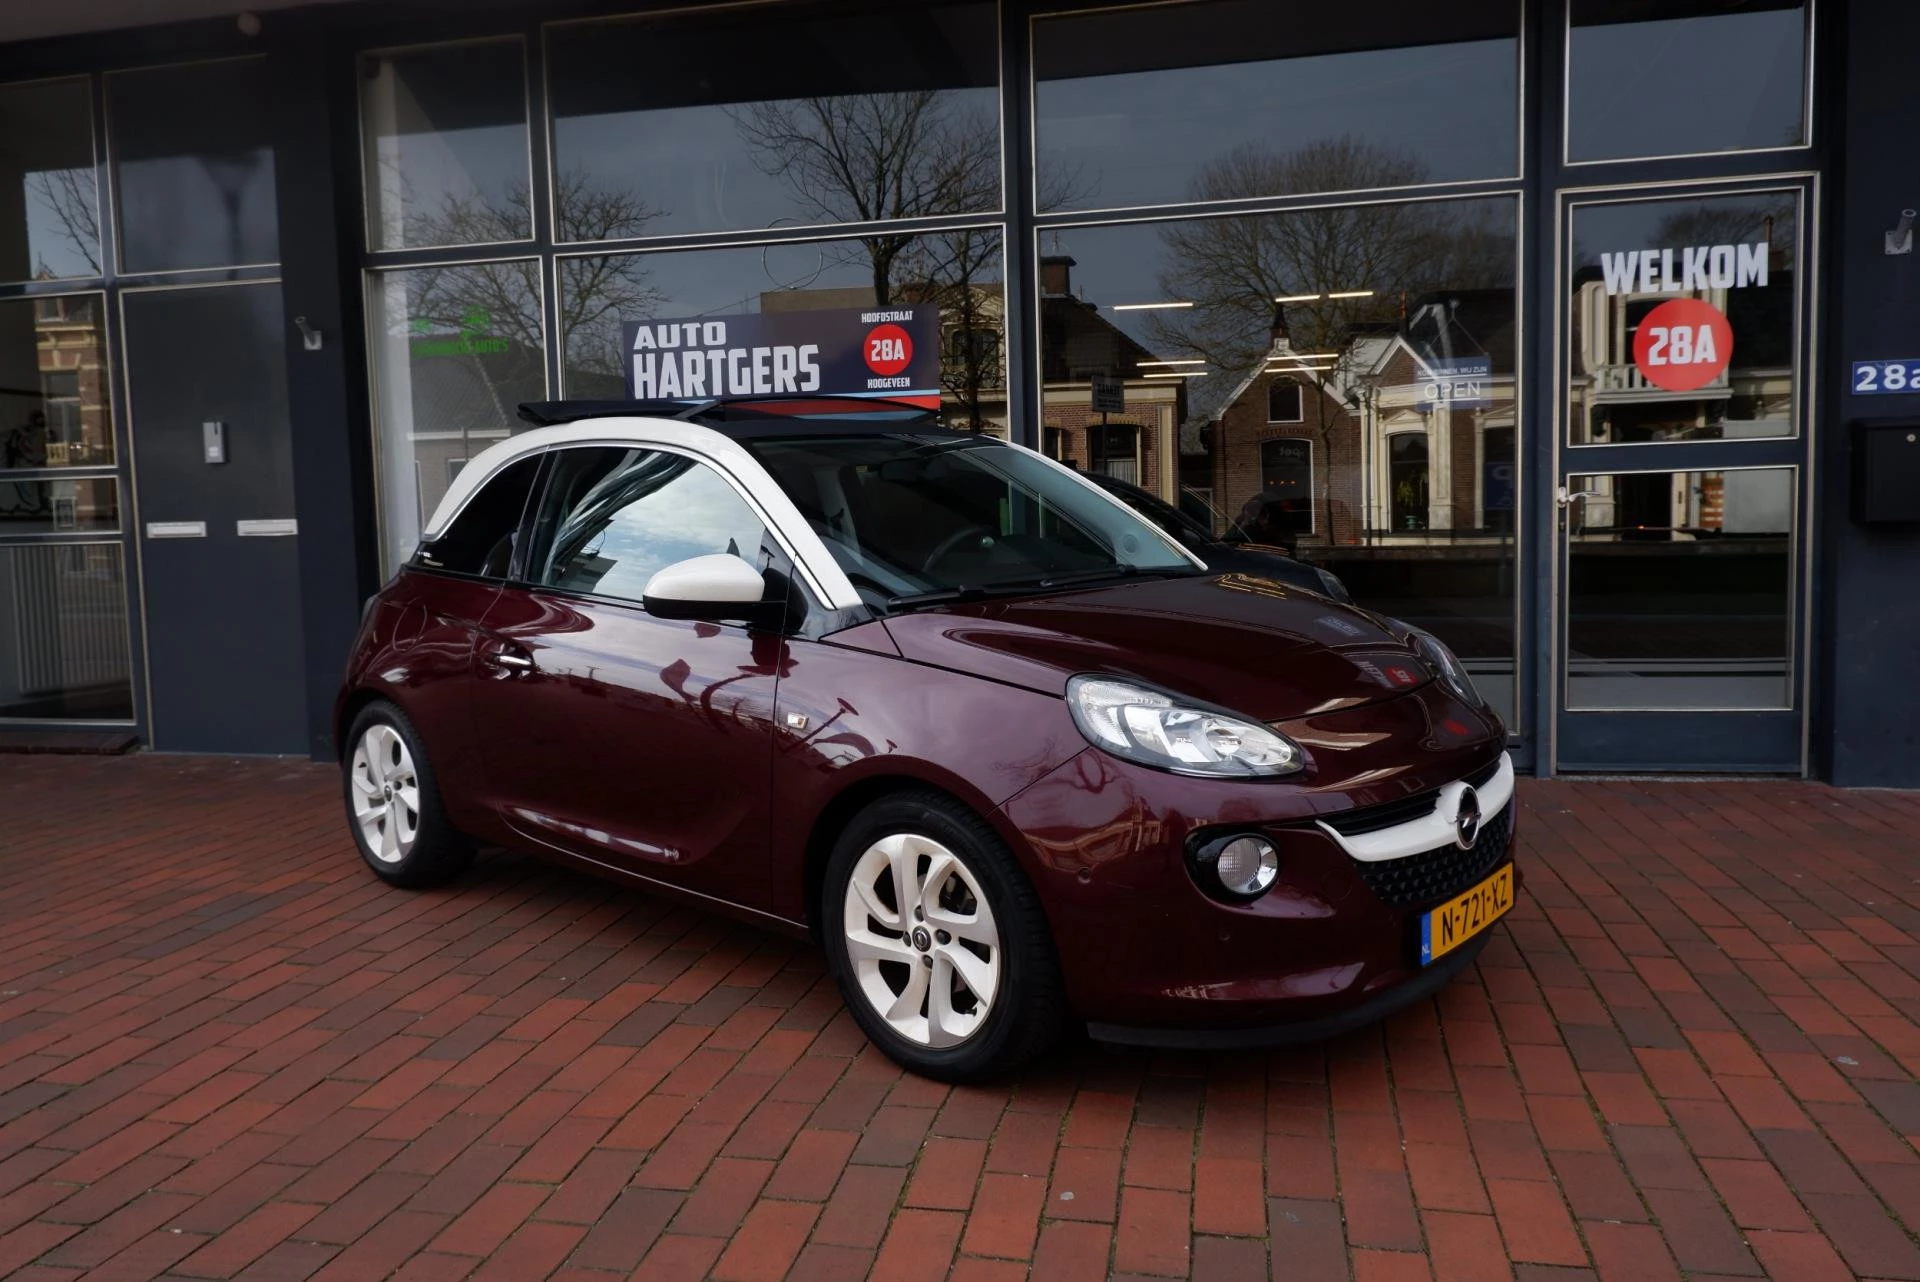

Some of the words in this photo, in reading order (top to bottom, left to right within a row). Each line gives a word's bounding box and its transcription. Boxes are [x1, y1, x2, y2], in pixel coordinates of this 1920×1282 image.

[1601, 242, 1769, 295] WELKOM
[861, 310, 913, 323] HOOFDSTRAAT
[633, 321, 726, 350] AUTO
[1648, 324, 1717, 366] 28A
[871, 338, 905, 362] 28A
[633, 344, 820, 400] HARTGERS
[867, 377, 911, 389] HOOGEVEEN
[1424, 381, 1480, 399] OPEN
[1441, 873, 1508, 946] N-721-XZ
[1421, 944, 1430, 956] NL
